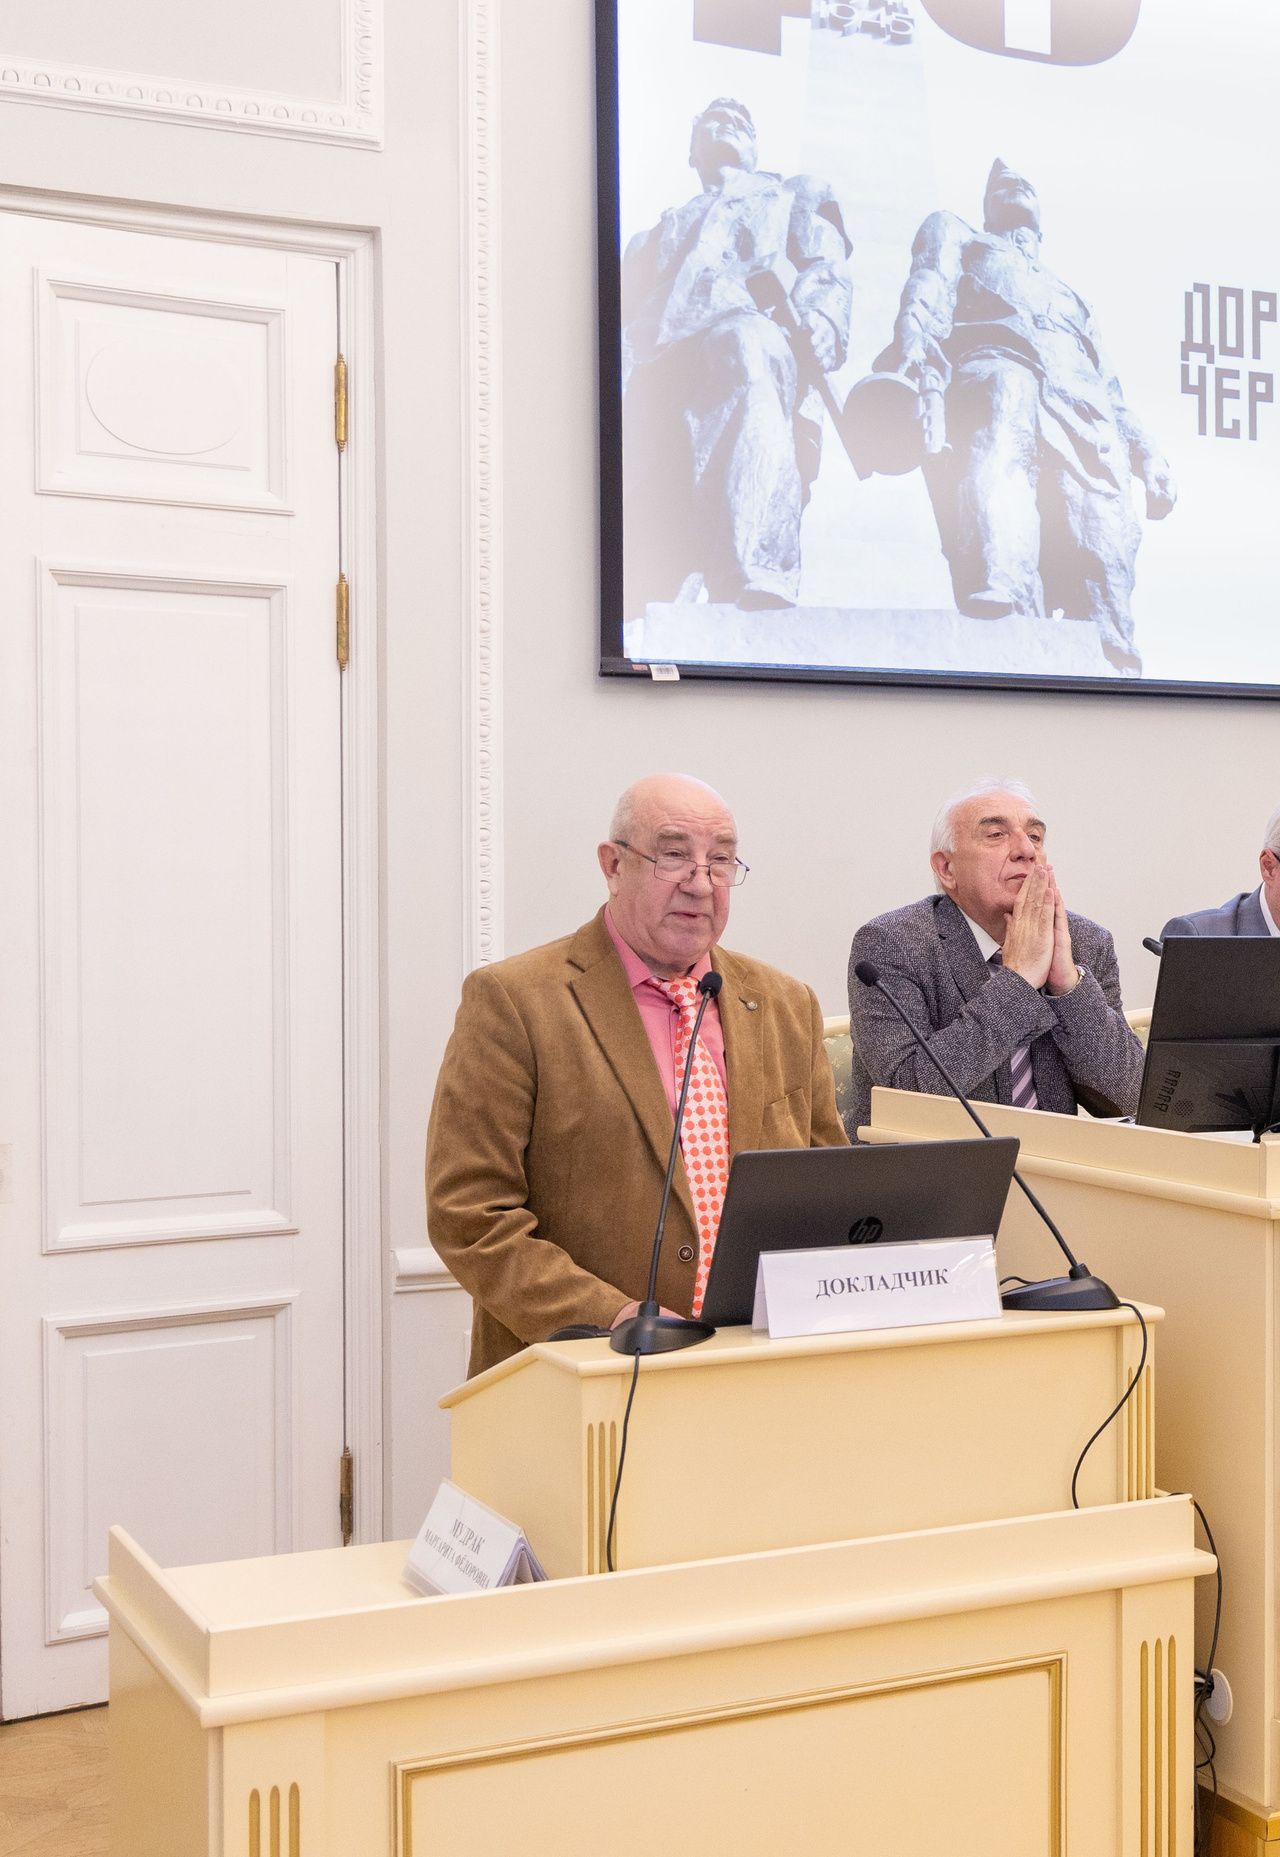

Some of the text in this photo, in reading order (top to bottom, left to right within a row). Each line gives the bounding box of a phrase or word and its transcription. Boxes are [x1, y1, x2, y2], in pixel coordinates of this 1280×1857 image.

[815, 1268, 950, 1301] ДОКЛАДЧИК
[424, 1528, 456, 1564] МАРГАРИТА
[448, 1518, 486, 1555] МУДРАК
